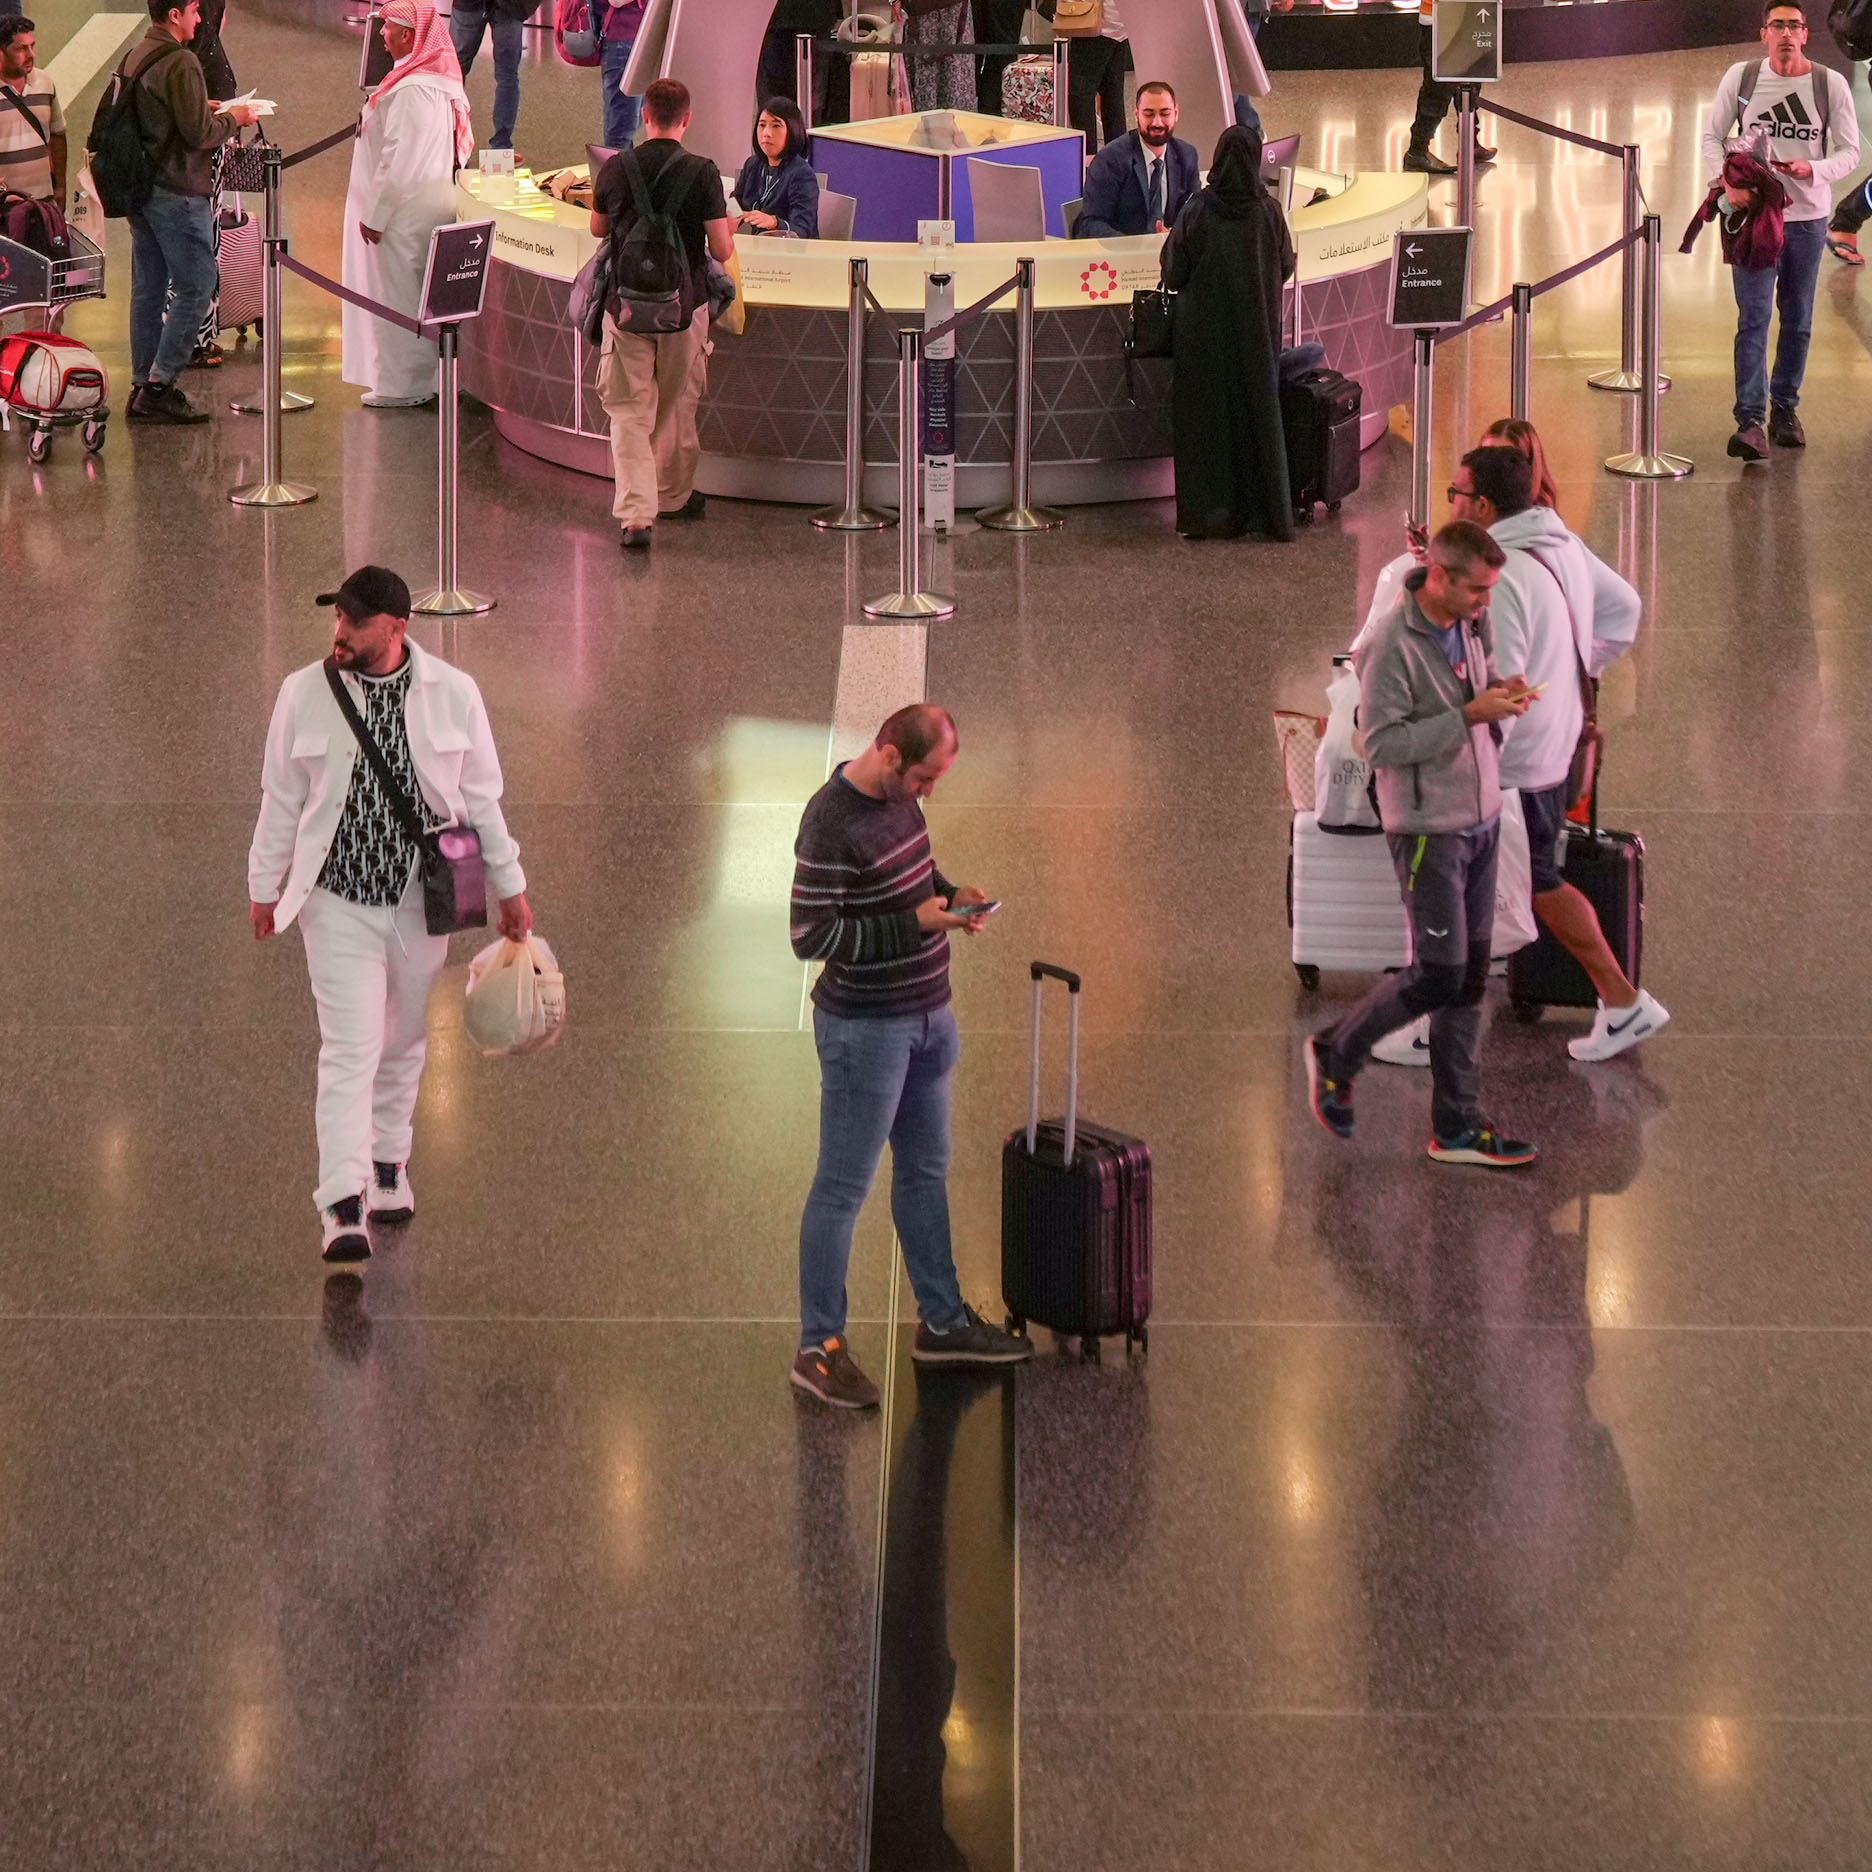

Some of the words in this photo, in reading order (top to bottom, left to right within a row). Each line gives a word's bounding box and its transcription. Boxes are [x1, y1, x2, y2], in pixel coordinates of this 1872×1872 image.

[1476, 40, 1492, 48] Exit
[496, 231, 534, 252] Information
[536, 244, 555, 257] Desk
[460, 258, 481, 270] مدخل
[446, 270, 478, 282] Entrance
[1402, 266, 1428, 278] مدخل
[1402, 278, 1442, 288] Entrance
